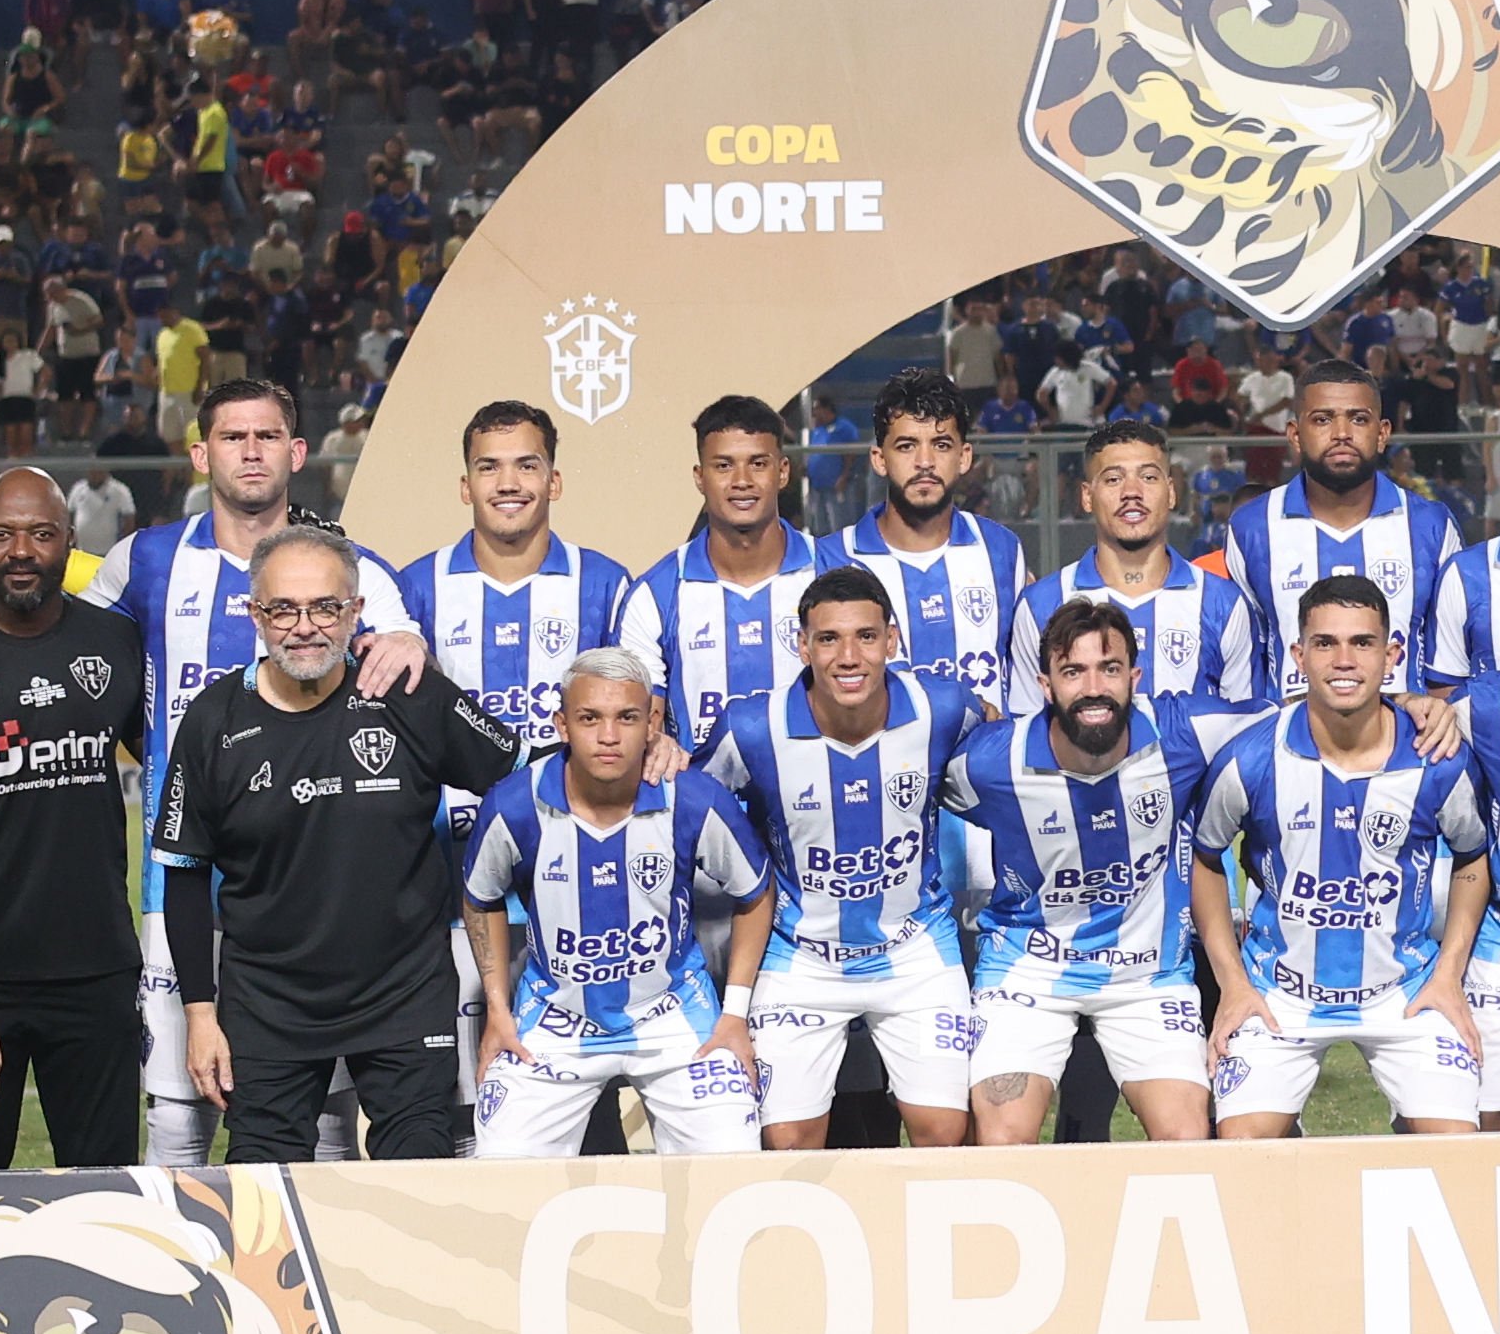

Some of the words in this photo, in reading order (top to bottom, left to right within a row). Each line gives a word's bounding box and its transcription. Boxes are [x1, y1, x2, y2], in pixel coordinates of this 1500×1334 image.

[706, 123, 841, 166] COPA
[665, 180, 885, 236] NORTE
[573, 357, 607, 374] CBF
[19, 688, 67, 705] CHEFE
[457, 698, 513, 750] DIMAGEM
[58, 774, 70, 786] de
[164, 763, 184, 841] DIMAGEM
[807, 846, 880, 875] Bet
[802, 873, 825, 890] dá
[829, 870, 908, 899] Sorte
[1055, 864, 1130, 889] Bet
[1292, 871, 1360, 906] Bet
[1045, 891, 1074, 904] dá
[1079, 887, 1146, 906] Sort
[1282, 900, 1305, 917] dá
[1308, 907, 1382, 928] Sorte
[556, 927, 625, 958] Bet
[834, 915, 919, 963] Banpará
[1064, 946, 1158, 967] Banpará
[550, 957, 568, 975] dá
[571, 959, 656, 983] Sorte
[1308, 973, 1406, 1005] Banpar
[748, 1009, 826, 1031] APÃO
[1159, 1000, 1198, 1017] SE
[934, 1012, 967, 1034] SE
[1163, 1017, 1206, 1038] SÓC
[1437, 1053, 1479, 1076] SÓC
